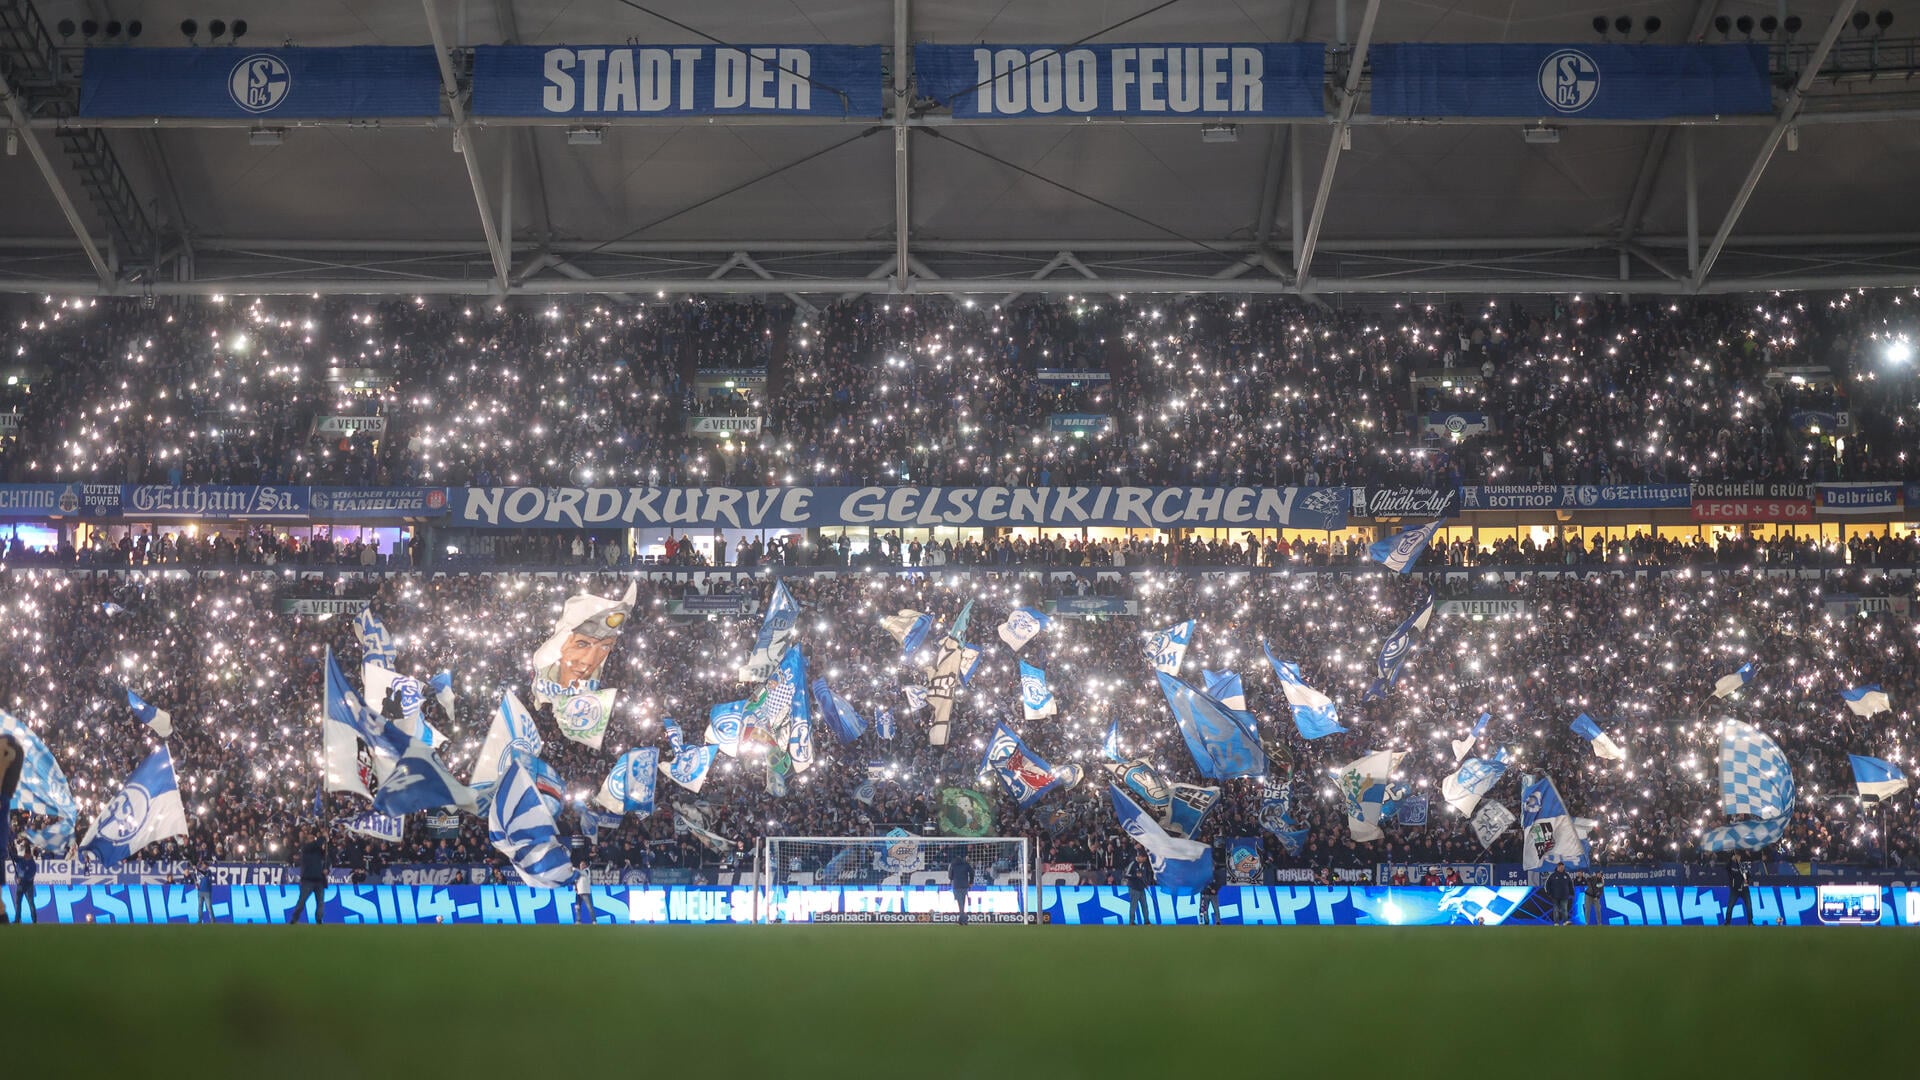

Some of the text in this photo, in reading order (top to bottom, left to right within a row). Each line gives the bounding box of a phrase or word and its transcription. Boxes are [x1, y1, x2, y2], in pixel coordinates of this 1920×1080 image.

[543, 48, 811, 112] STADT DER
[974, 47, 1264, 114] 1000 FEUER
[338, 420, 382, 430] VELTINS
[712, 419, 757, 430] VELTINS
[83, 484, 121, 494] KUTTEN
[331, 490, 424, 498] SCHALKER FILIALE
[1484, 485, 1558, 494] RUHRKNAPPEN
[1690, 483, 1764, 497] FORCHHEIM
[85, 496, 119, 506] POWER
[1370, 489, 1455, 514] Glück Auf
[1489, 495, 1553, 507] BOTTROP
[1827, 490, 1892, 504] Delbrück
[332, 499, 423, 511] HAMBURG
[464, 487, 1294, 528] NORDKURVE GELSENKIRCHEN
[1785, 504, 1808, 516] 04
[1461, 601, 1517, 614] VELTINS
[669, 890, 727, 921] NEUE
[814, 911, 872, 922] Eisenbach
